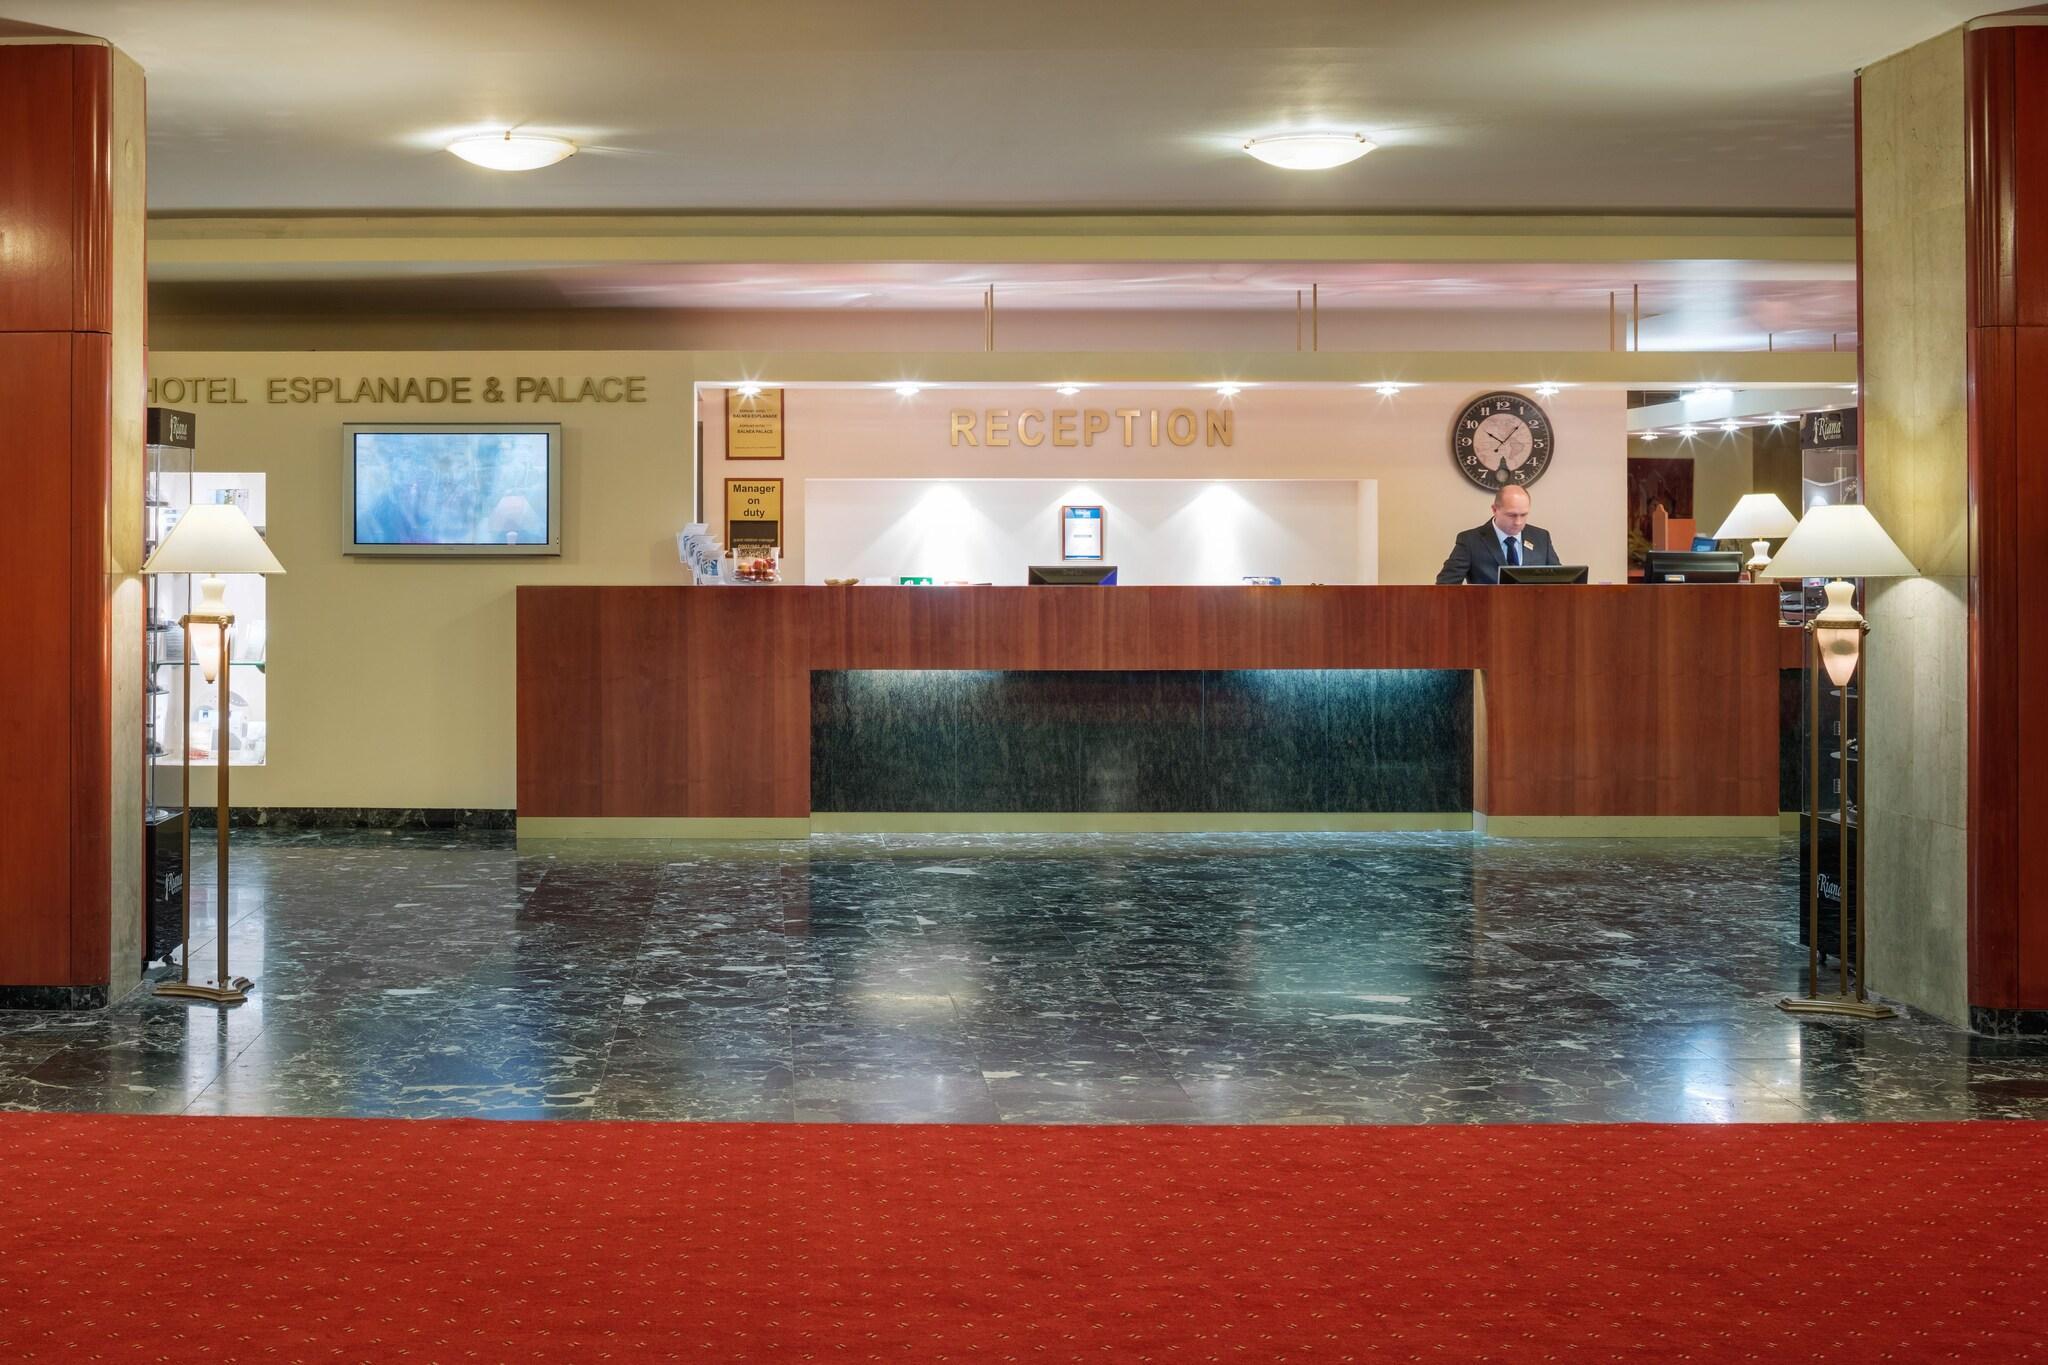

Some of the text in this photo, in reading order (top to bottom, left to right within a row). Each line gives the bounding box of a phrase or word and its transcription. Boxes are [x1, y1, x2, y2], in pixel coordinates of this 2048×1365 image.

[266, 377, 472, 404] ESPLANADE
[482, 376, 505, 403] &
[515, 376, 648, 403] PALACE
[1495, 401, 1511, 411] 12
[1480, 407, 1490, 416] 11
[950, 408, 1234, 448] RECEPTION
[1466, 420, 1479, 429] 10
[1528, 419, 1540, 429] 2
[1461, 437, 1472, 446] 9
[1533, 439, 1545, 449] 3
[1466, 455, 1477, 465] 8
[1526, 457, 1539, 466] 4
[1478, 469, 1489, 478] 7
[1514, 470, 1525, 480] 5
[733, 484, 776, 494] Manager
[743, 508, 765, 518] duty
